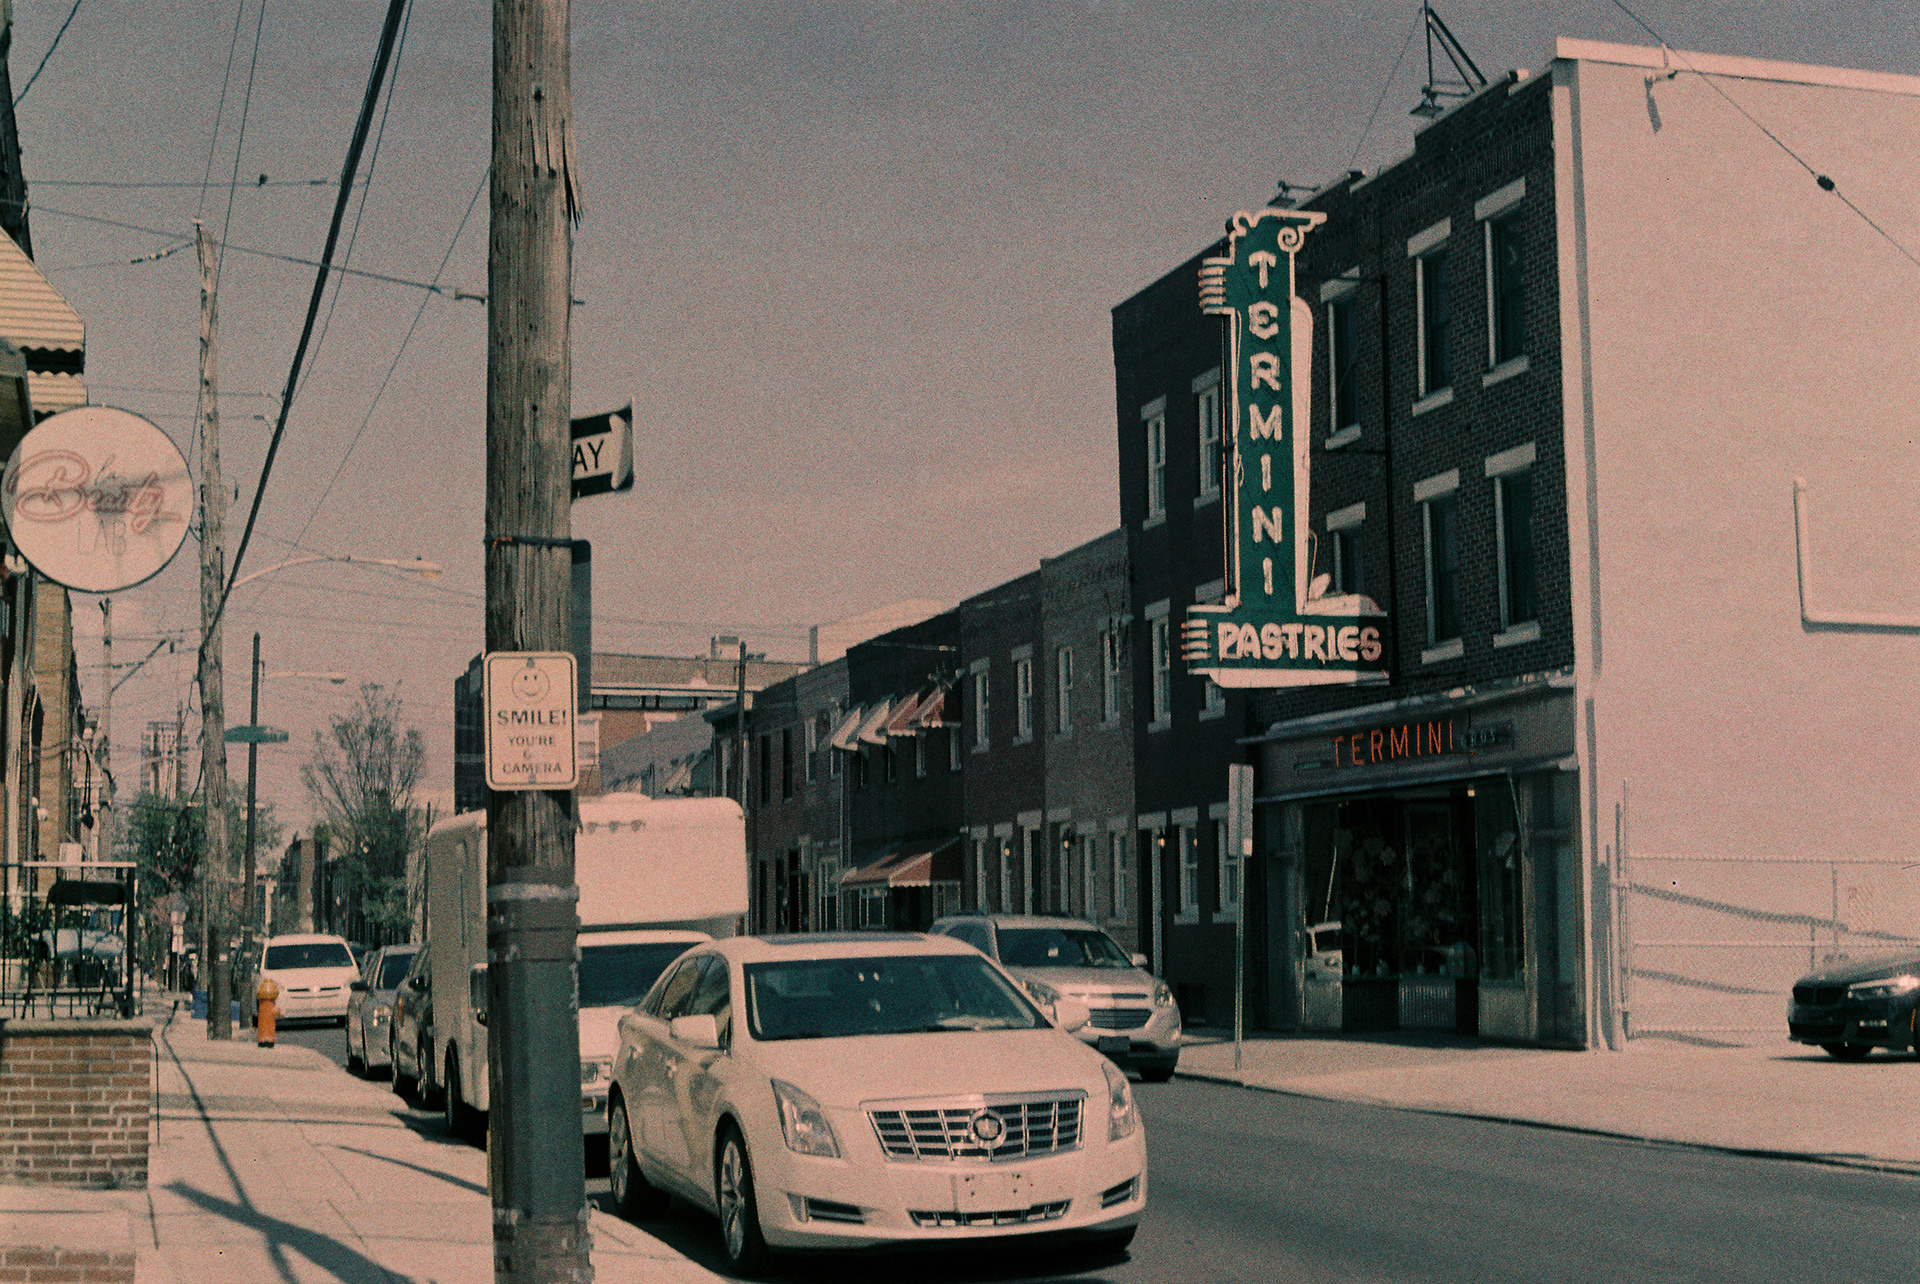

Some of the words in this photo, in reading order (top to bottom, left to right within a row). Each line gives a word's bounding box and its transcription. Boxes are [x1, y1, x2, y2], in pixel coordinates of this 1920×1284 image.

[1247, 250, 1283, 597] TERMINI
[572, 440, 604, 477] AY
[1217, 622, 1382, 663] PASTRIES
[497, 709, 567, 726] SMILE!
[1331, 718, 1454, 767] TERMINI
[502, 762, 562, 775] CAMERA
